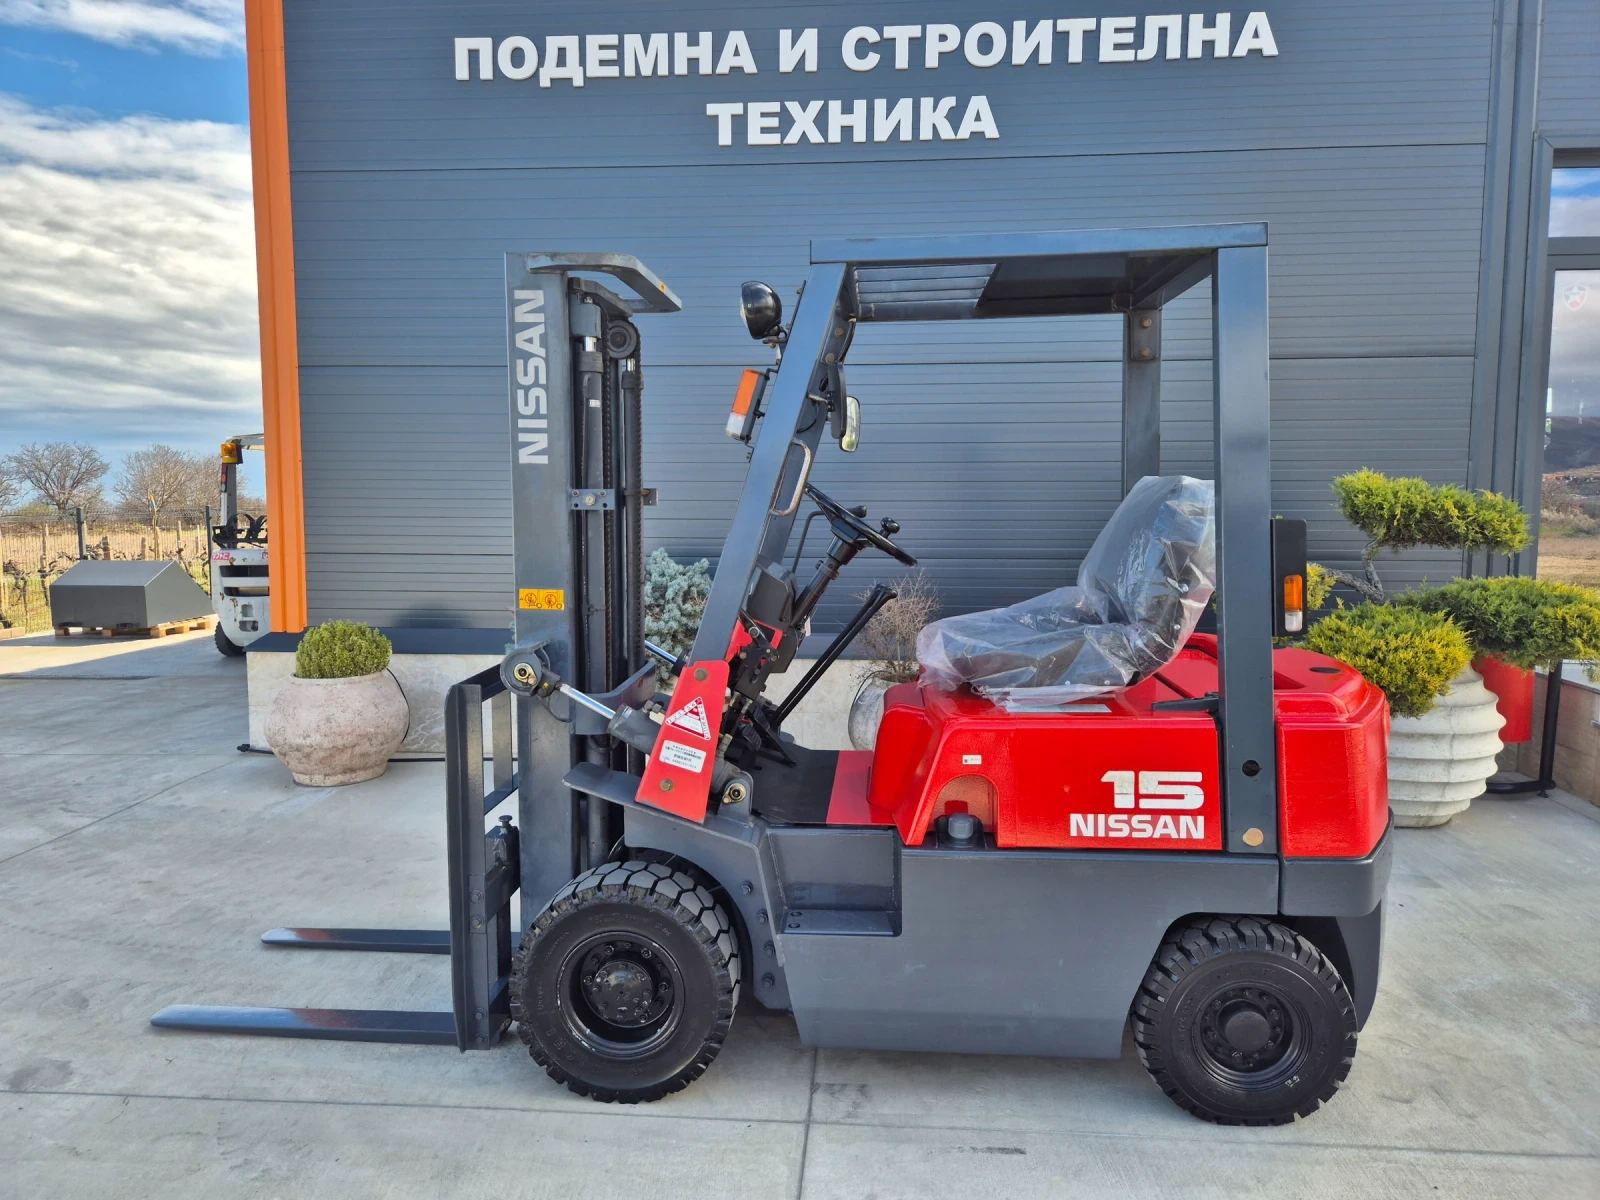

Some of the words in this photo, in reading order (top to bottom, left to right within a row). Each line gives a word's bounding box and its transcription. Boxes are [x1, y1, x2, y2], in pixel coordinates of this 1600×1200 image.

[454, 30, 758, 88] ПОДЕМНА
[779, 28, 818, 73] И
[841, 12, 1279, 71] СТРОИТЕЛНА
[706, 96, 1000, 146] ТЕХНИКА
[514, 290, 549, 465] NISSAN
[1101, 770, 1204, 810] 15
[1069, 813, 1205, 840] NISSAN
